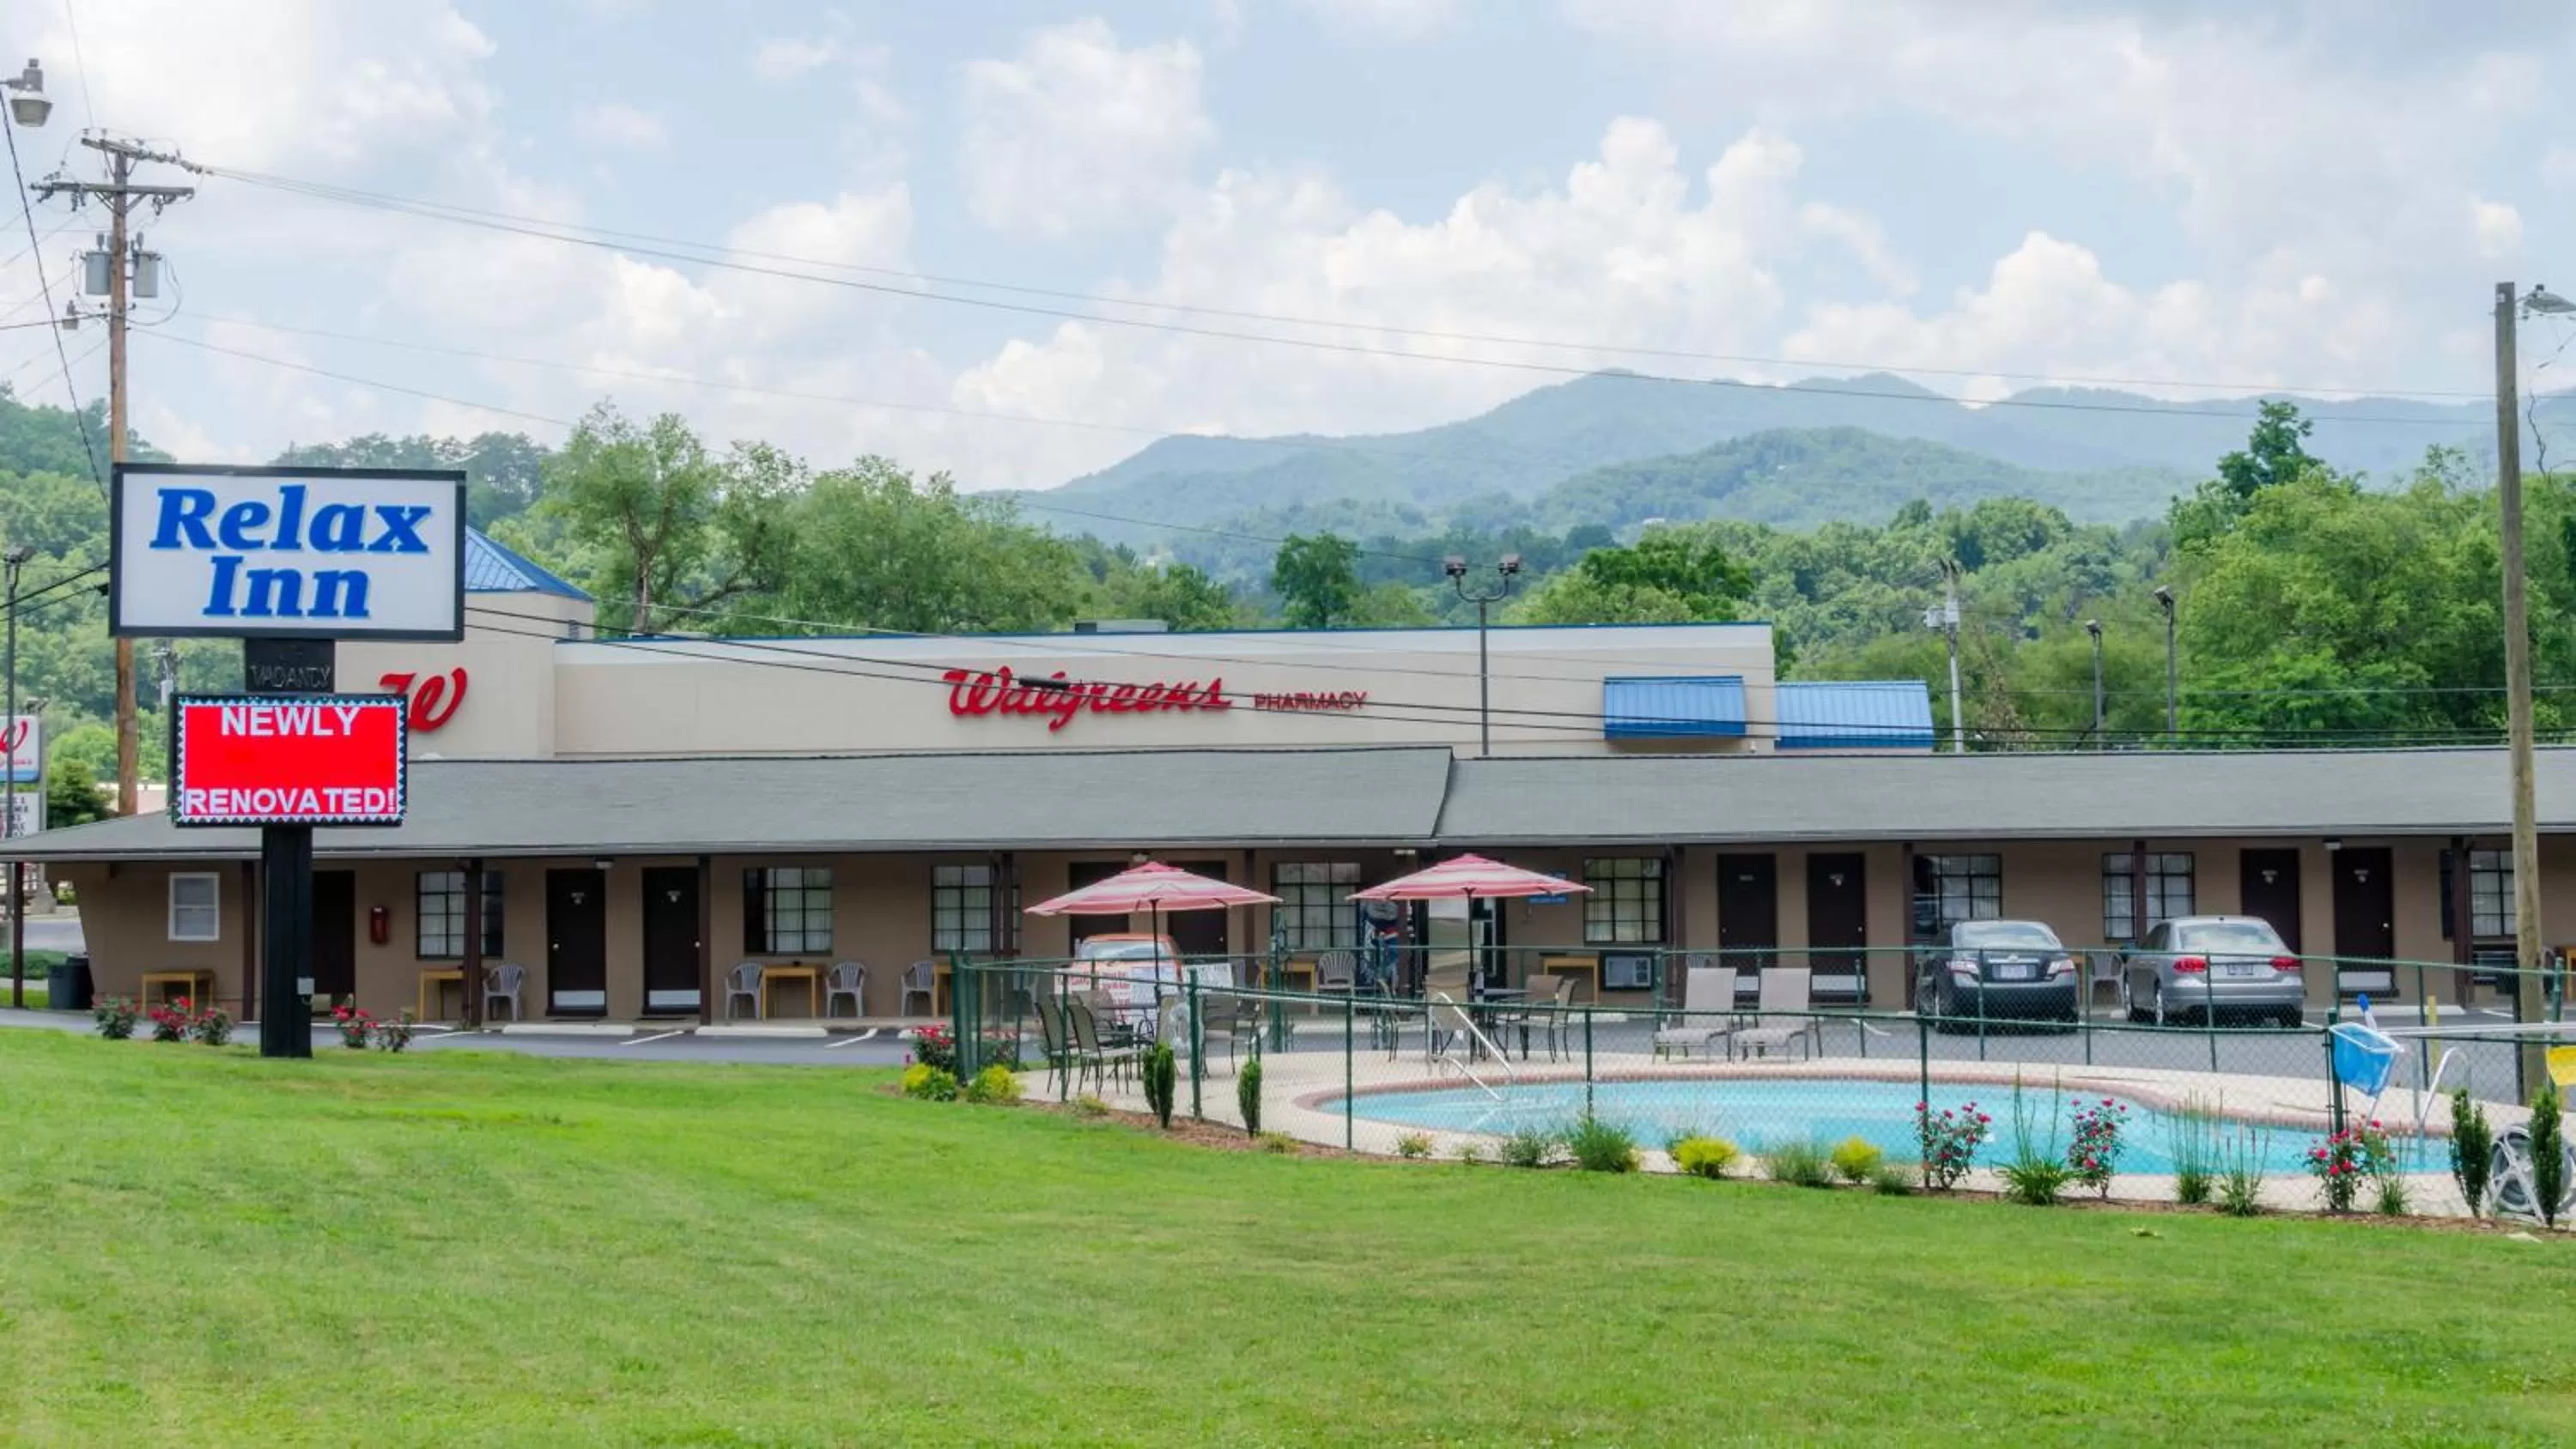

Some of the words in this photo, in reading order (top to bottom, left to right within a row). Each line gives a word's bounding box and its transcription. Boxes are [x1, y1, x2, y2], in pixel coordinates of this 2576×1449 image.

[149, 484, 431, 554] Relax
[202, 555, 370, 618] Inn
[250, 664, 331, 688] VACANCY
[380, 667, 468, 732] W
[942, 666, 1233, 732] Walgreens
[1254, 691, 1367, 710] PHARMACY
[221, 706, 361, 736] NEWLY
[185, 787, 396, 815] RENOVATED!
